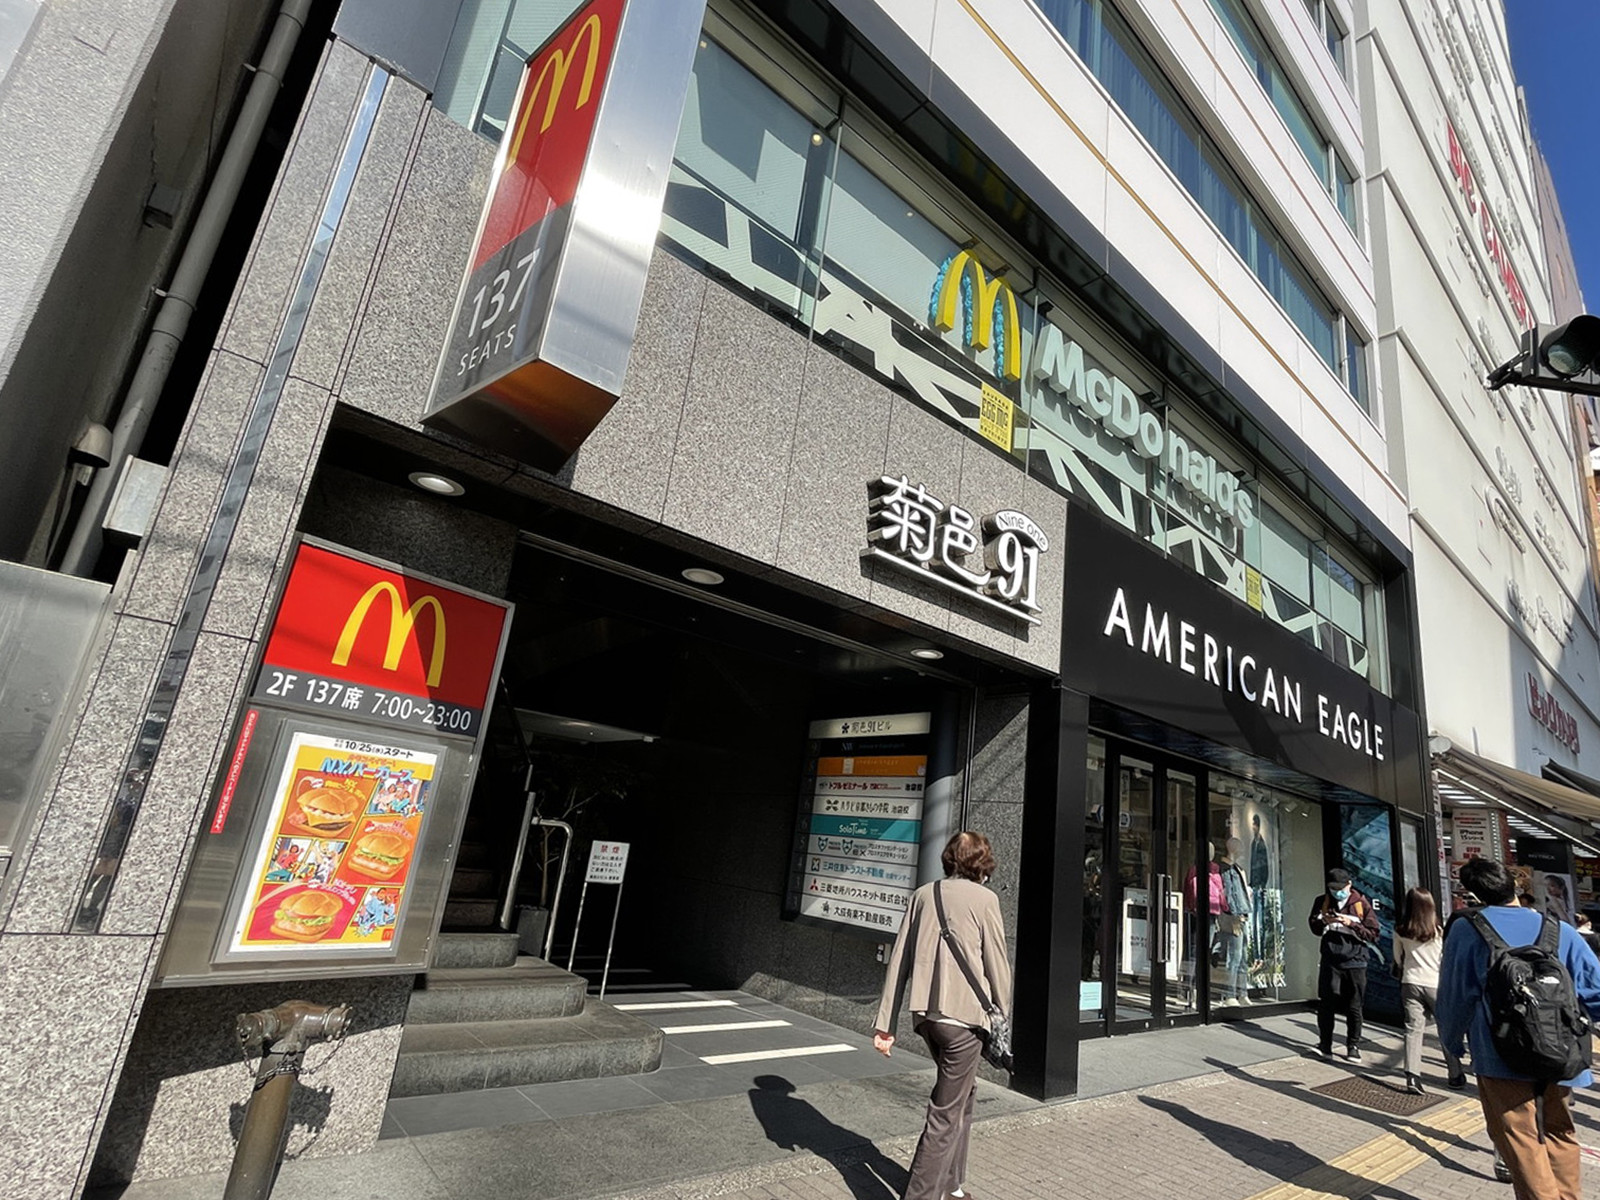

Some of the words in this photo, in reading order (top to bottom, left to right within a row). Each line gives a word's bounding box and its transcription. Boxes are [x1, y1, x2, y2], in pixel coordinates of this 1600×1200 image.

[467, 248, 540, 338] 137
[457, 324, 518, 377] SEATS
[1034, 322, 1254, 530] McDonald's
[999, 511, 1025, 530] Nine
[1026, 522, 1047, 548] one
[265, 671, 298, 697] 2F
[305, 678, 365, 711] 137席
[1103, 586, 1302, 724] AMERICAN
[1317, 694, 1385, 761] EAGLE
[819, 882, 909, 906] 三菱地所ハウスネット株式会社
